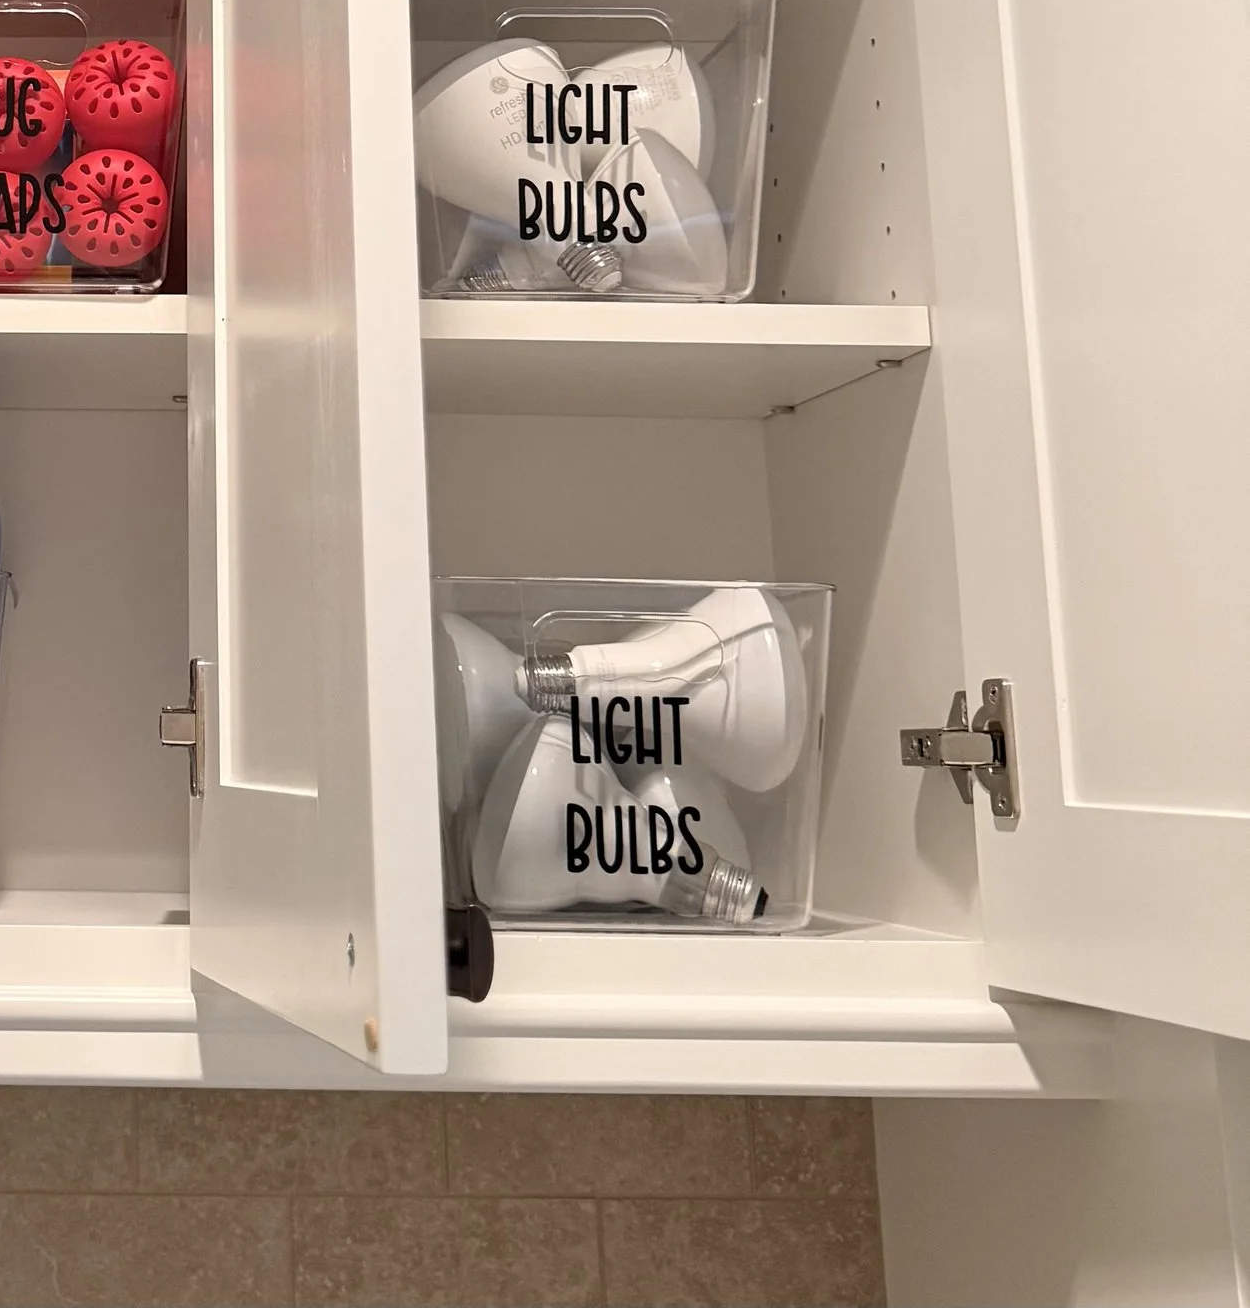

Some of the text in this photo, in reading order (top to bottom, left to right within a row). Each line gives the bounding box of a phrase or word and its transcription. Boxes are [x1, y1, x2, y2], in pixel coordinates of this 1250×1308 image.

[500, 131, 522, 150] HD
[526, 83, 638, 145] LIGHT
[518, 178, 647, 244] BULBS
[570, 695, 690, 766] LIGHT
[566, 803, 704, 876] BULBS
